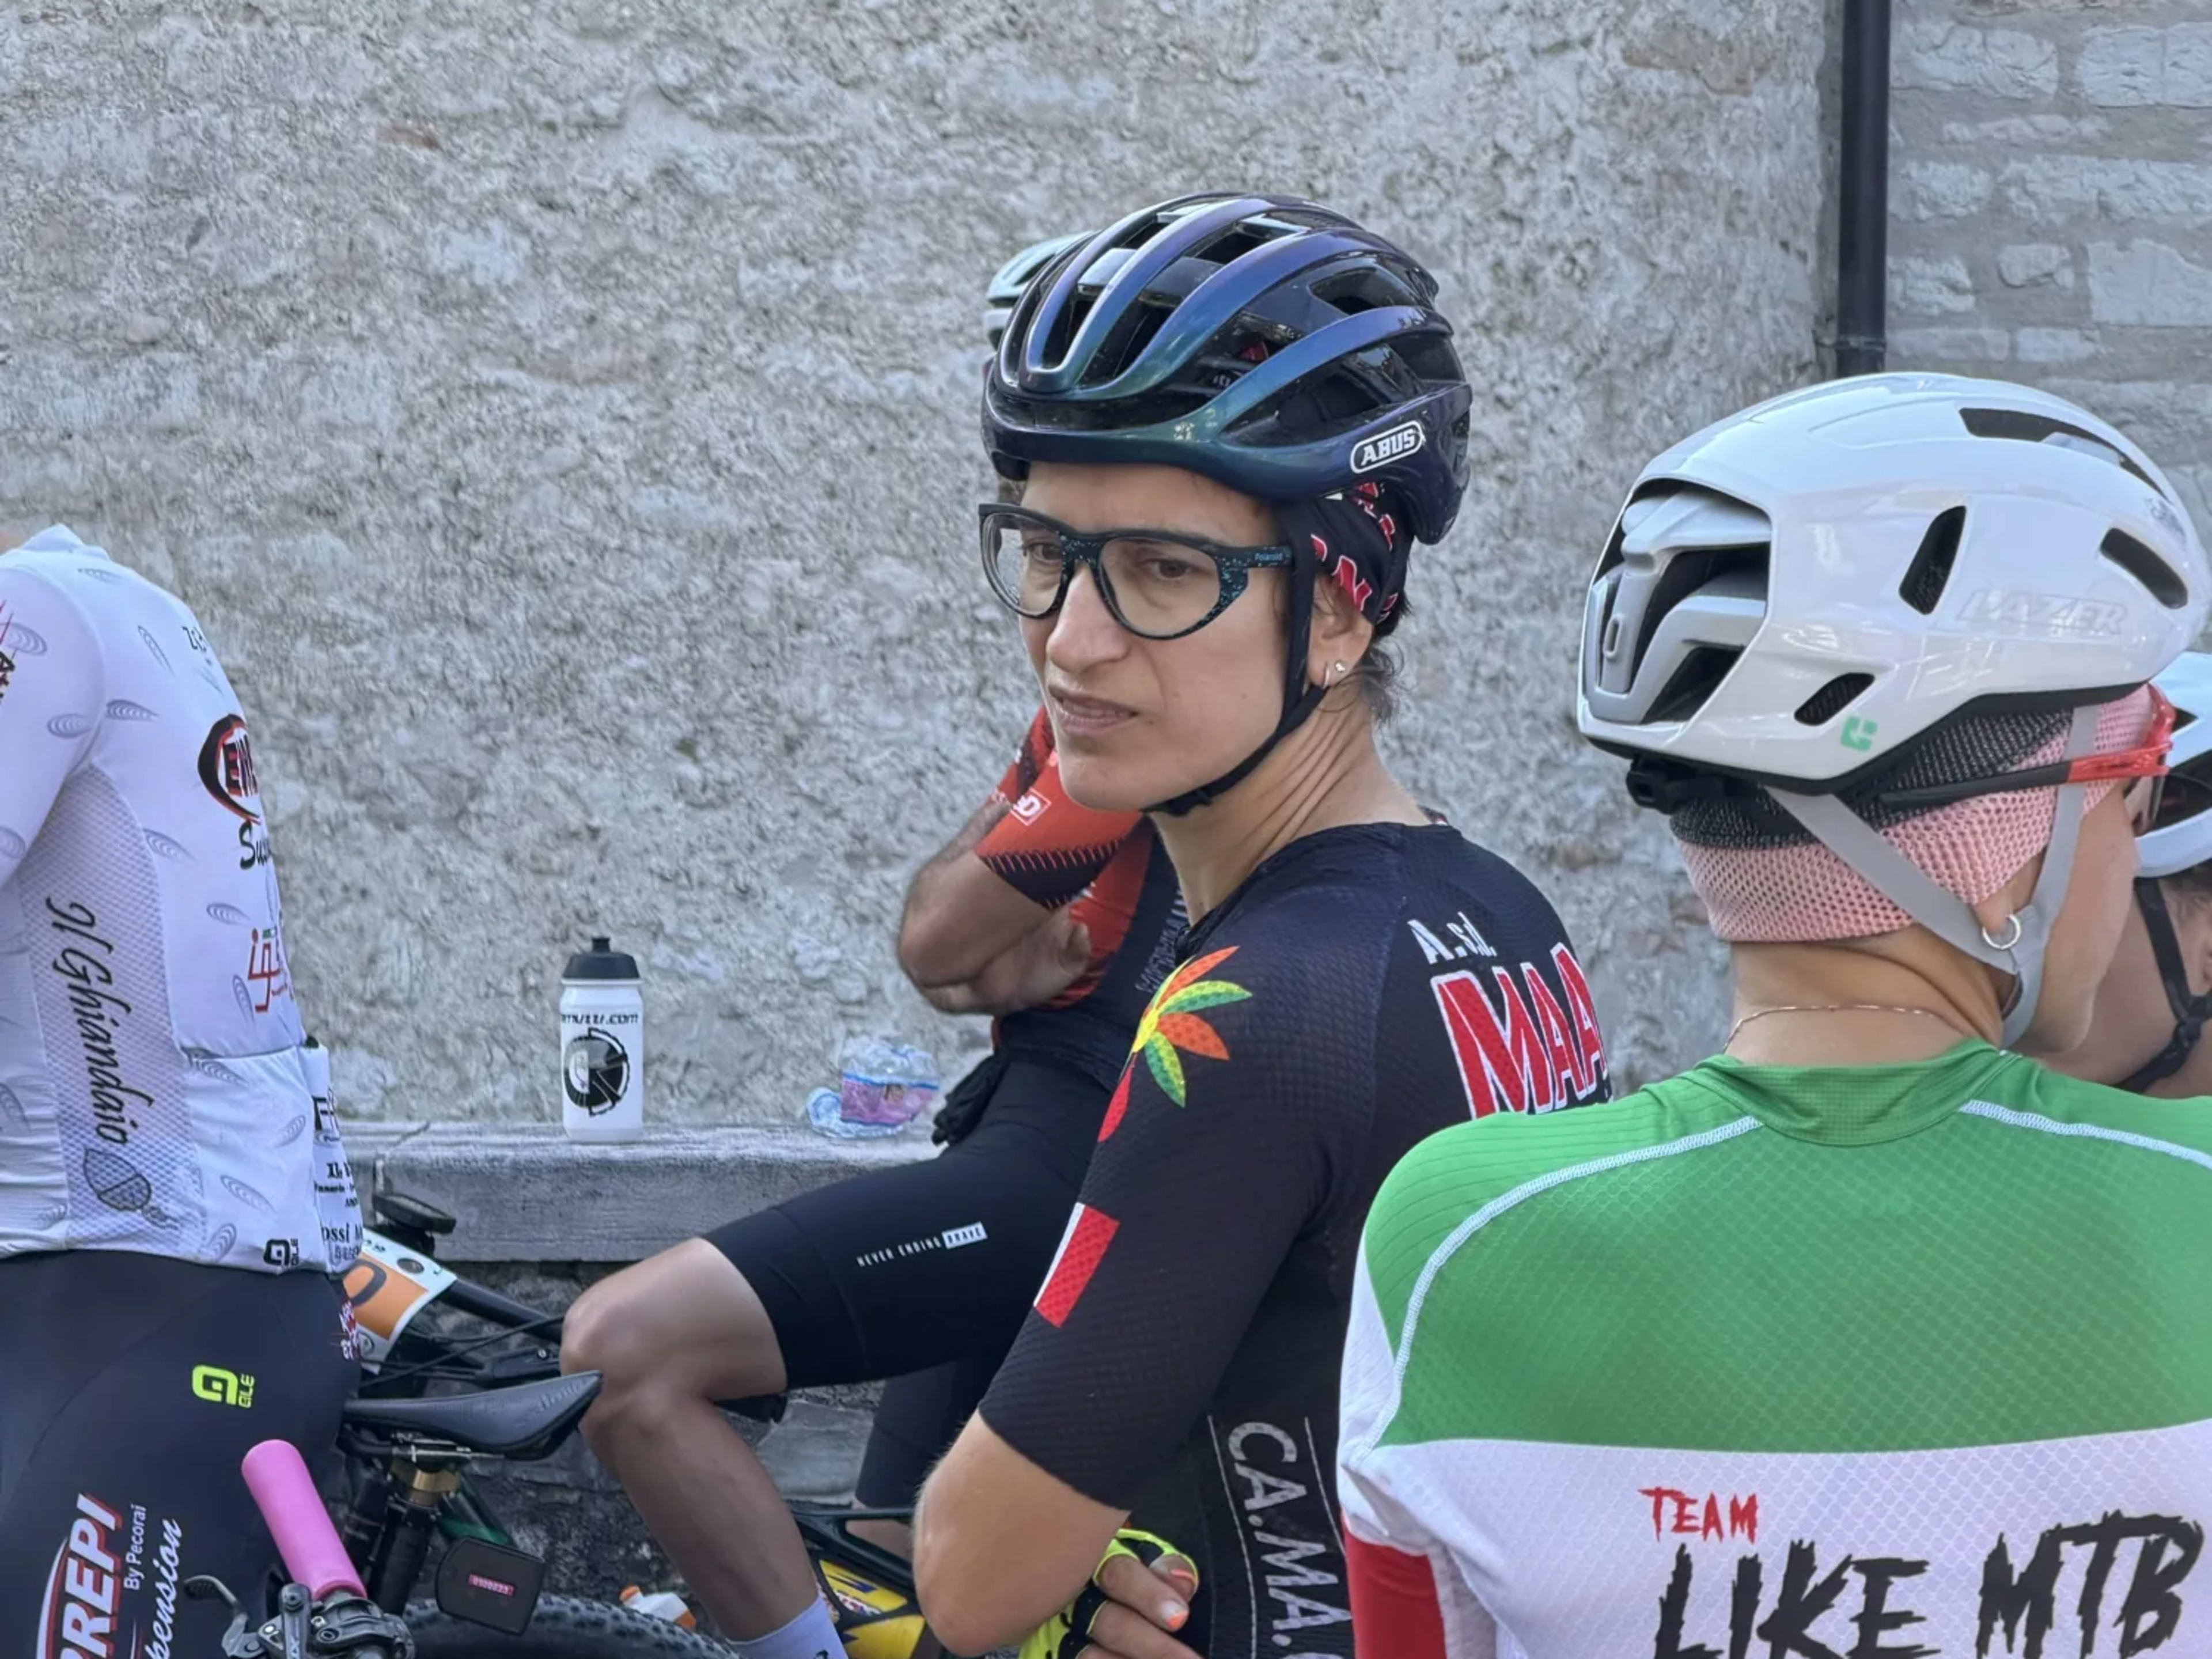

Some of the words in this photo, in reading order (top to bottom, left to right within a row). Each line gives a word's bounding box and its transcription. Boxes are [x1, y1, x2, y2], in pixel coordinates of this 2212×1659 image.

[1361, 429, 1415, 466] ABUS
[1955, 589, 2128, 635] LAZER
[53, 948, 155, 1145] Ghiandaio
[857, 1248, 894, 1267] NEVER
[897, 1237, 941, 1256] ENDING
[125, 1503, 147, 1566] Pecorai
[1228, 1422, 1352, 1659] CA.MA.
[1637, 1487, 1758, 1544] TEAM
[60, 1493, 122, 1659] REPI
[123, 1567, 145, 1590] By
[1653, 1539, 1942, 1659] LIKE
[1976, 1509, 2205, 1659] MTB
